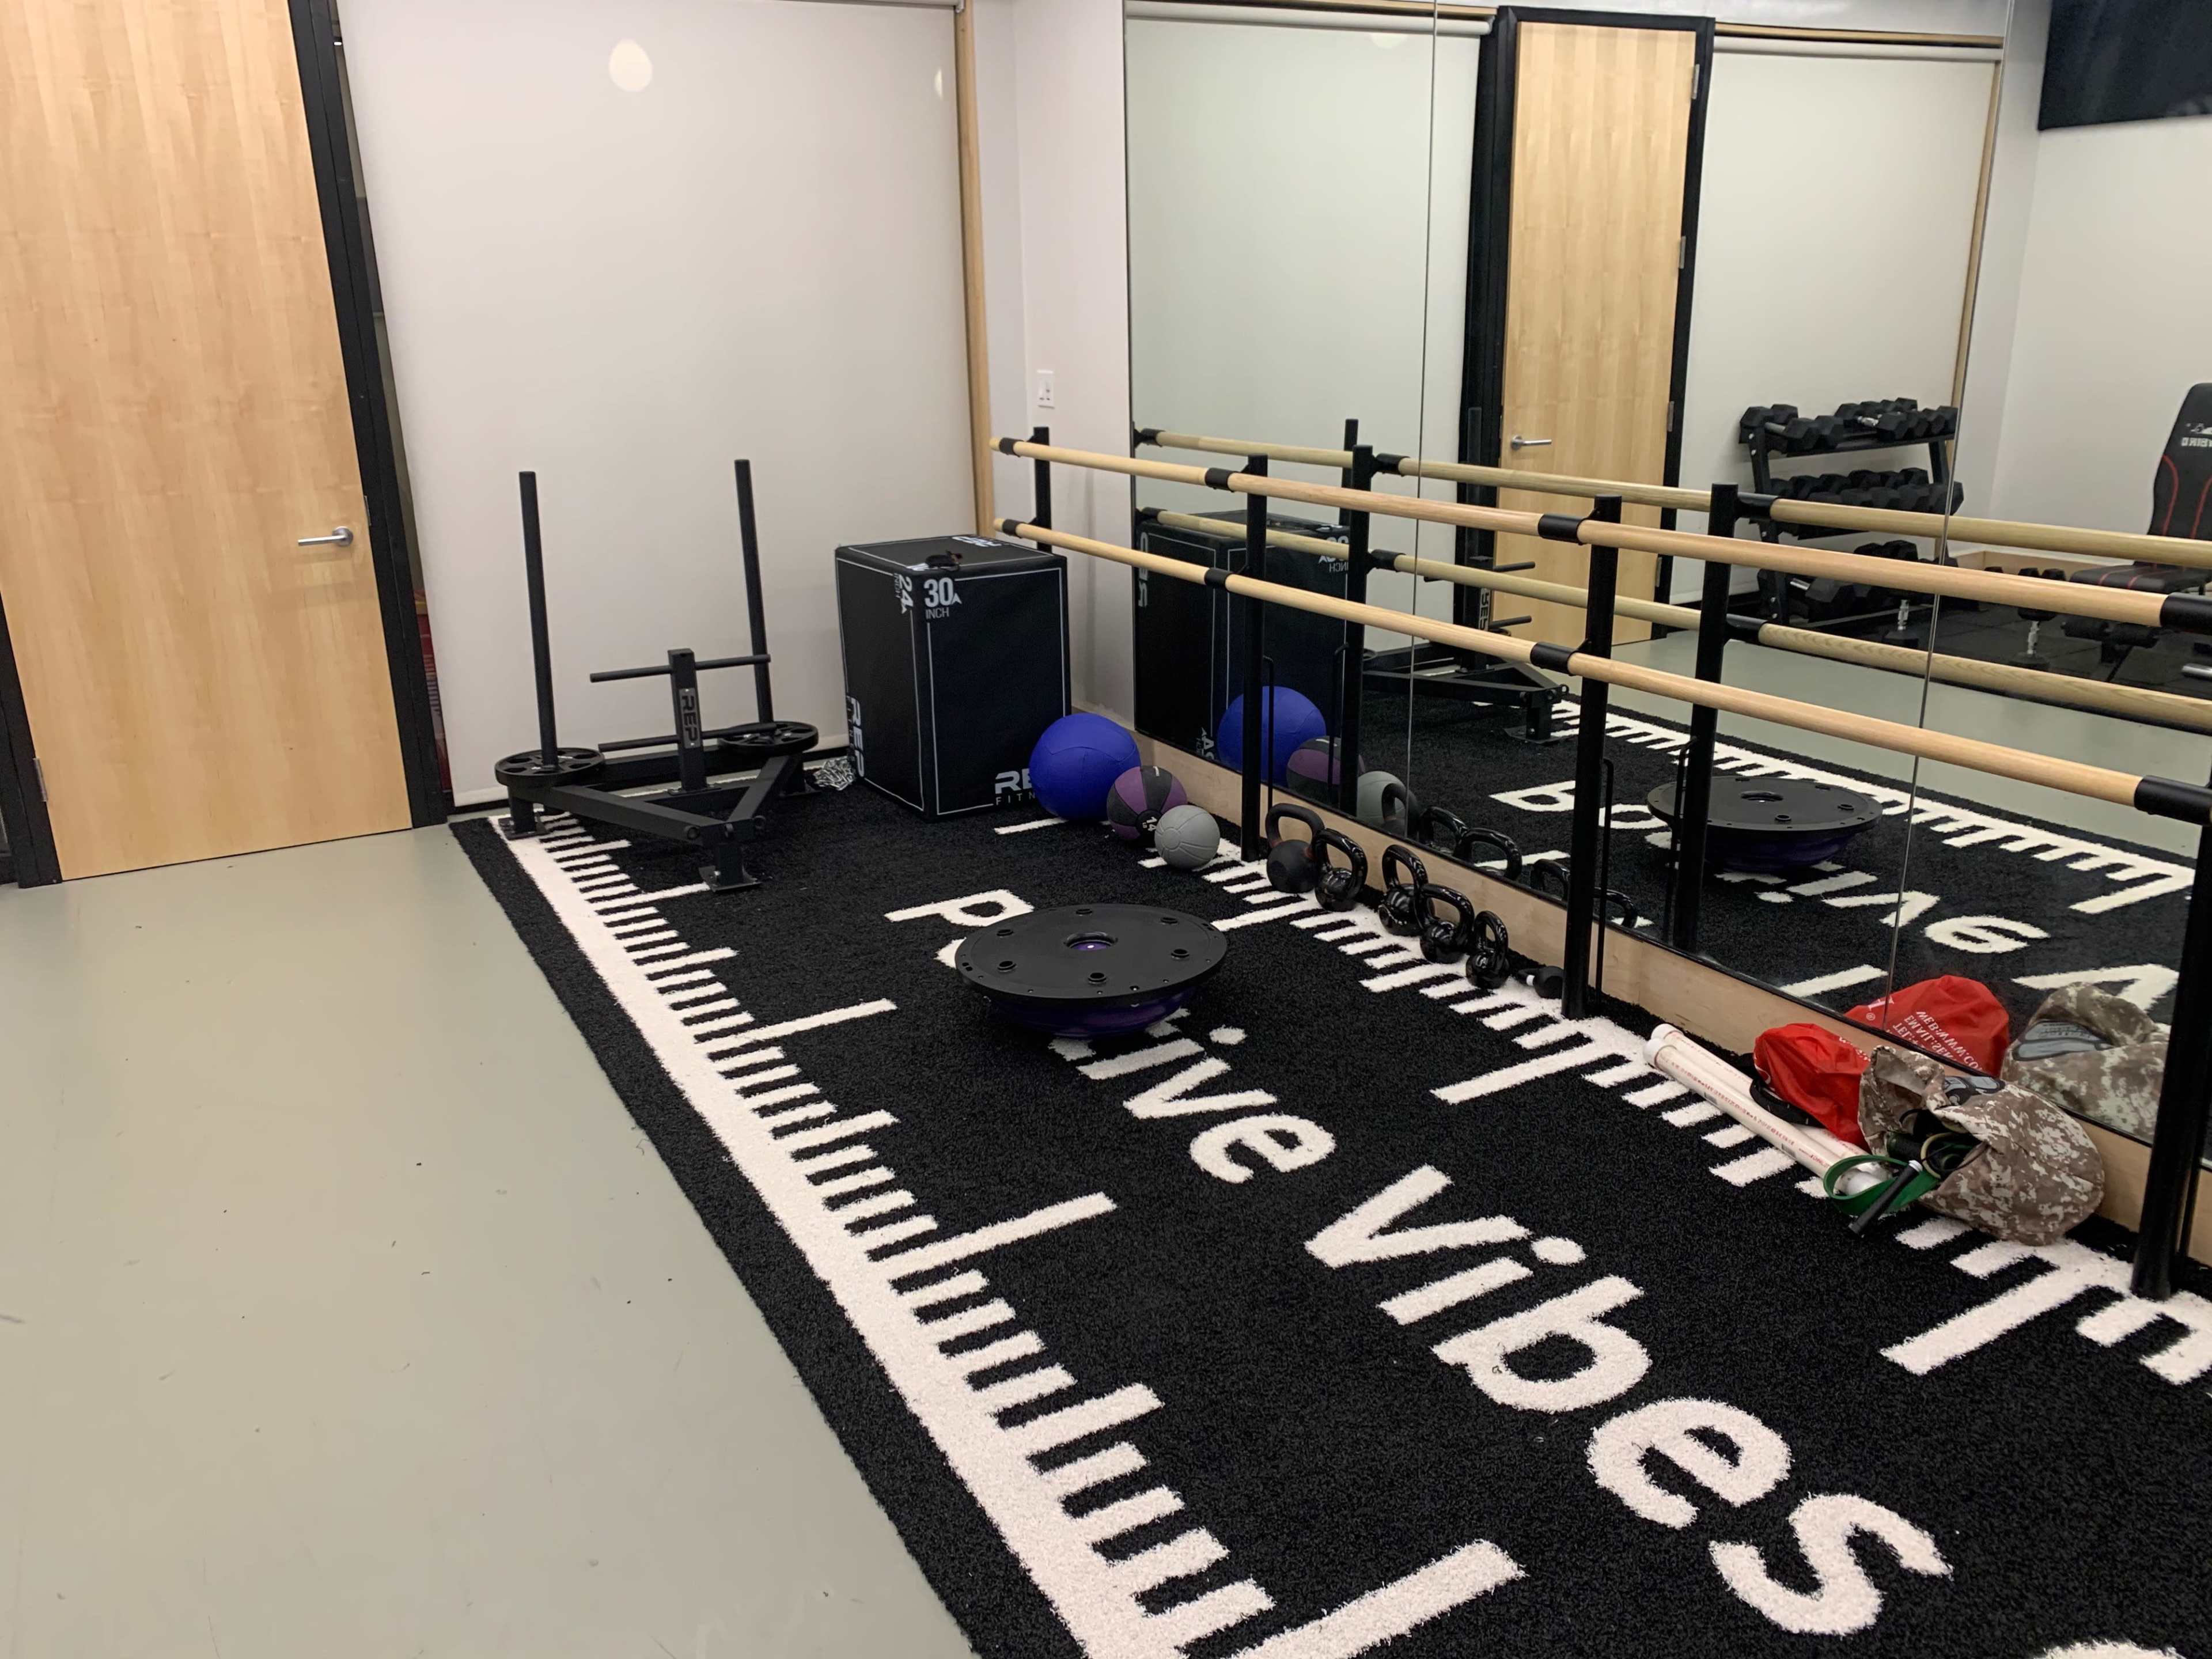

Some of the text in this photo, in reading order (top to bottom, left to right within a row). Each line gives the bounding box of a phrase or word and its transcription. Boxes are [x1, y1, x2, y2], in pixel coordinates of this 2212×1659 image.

[923, 577, 954, 608] 30
[925, 607, 950, 620] INCH
[682, 695, 698, 741] REP
[851, 696, 864, 777] REP
[995, 791, 1036, 805] FITN
[1304, 1164, 1954, 1636] Vibes
